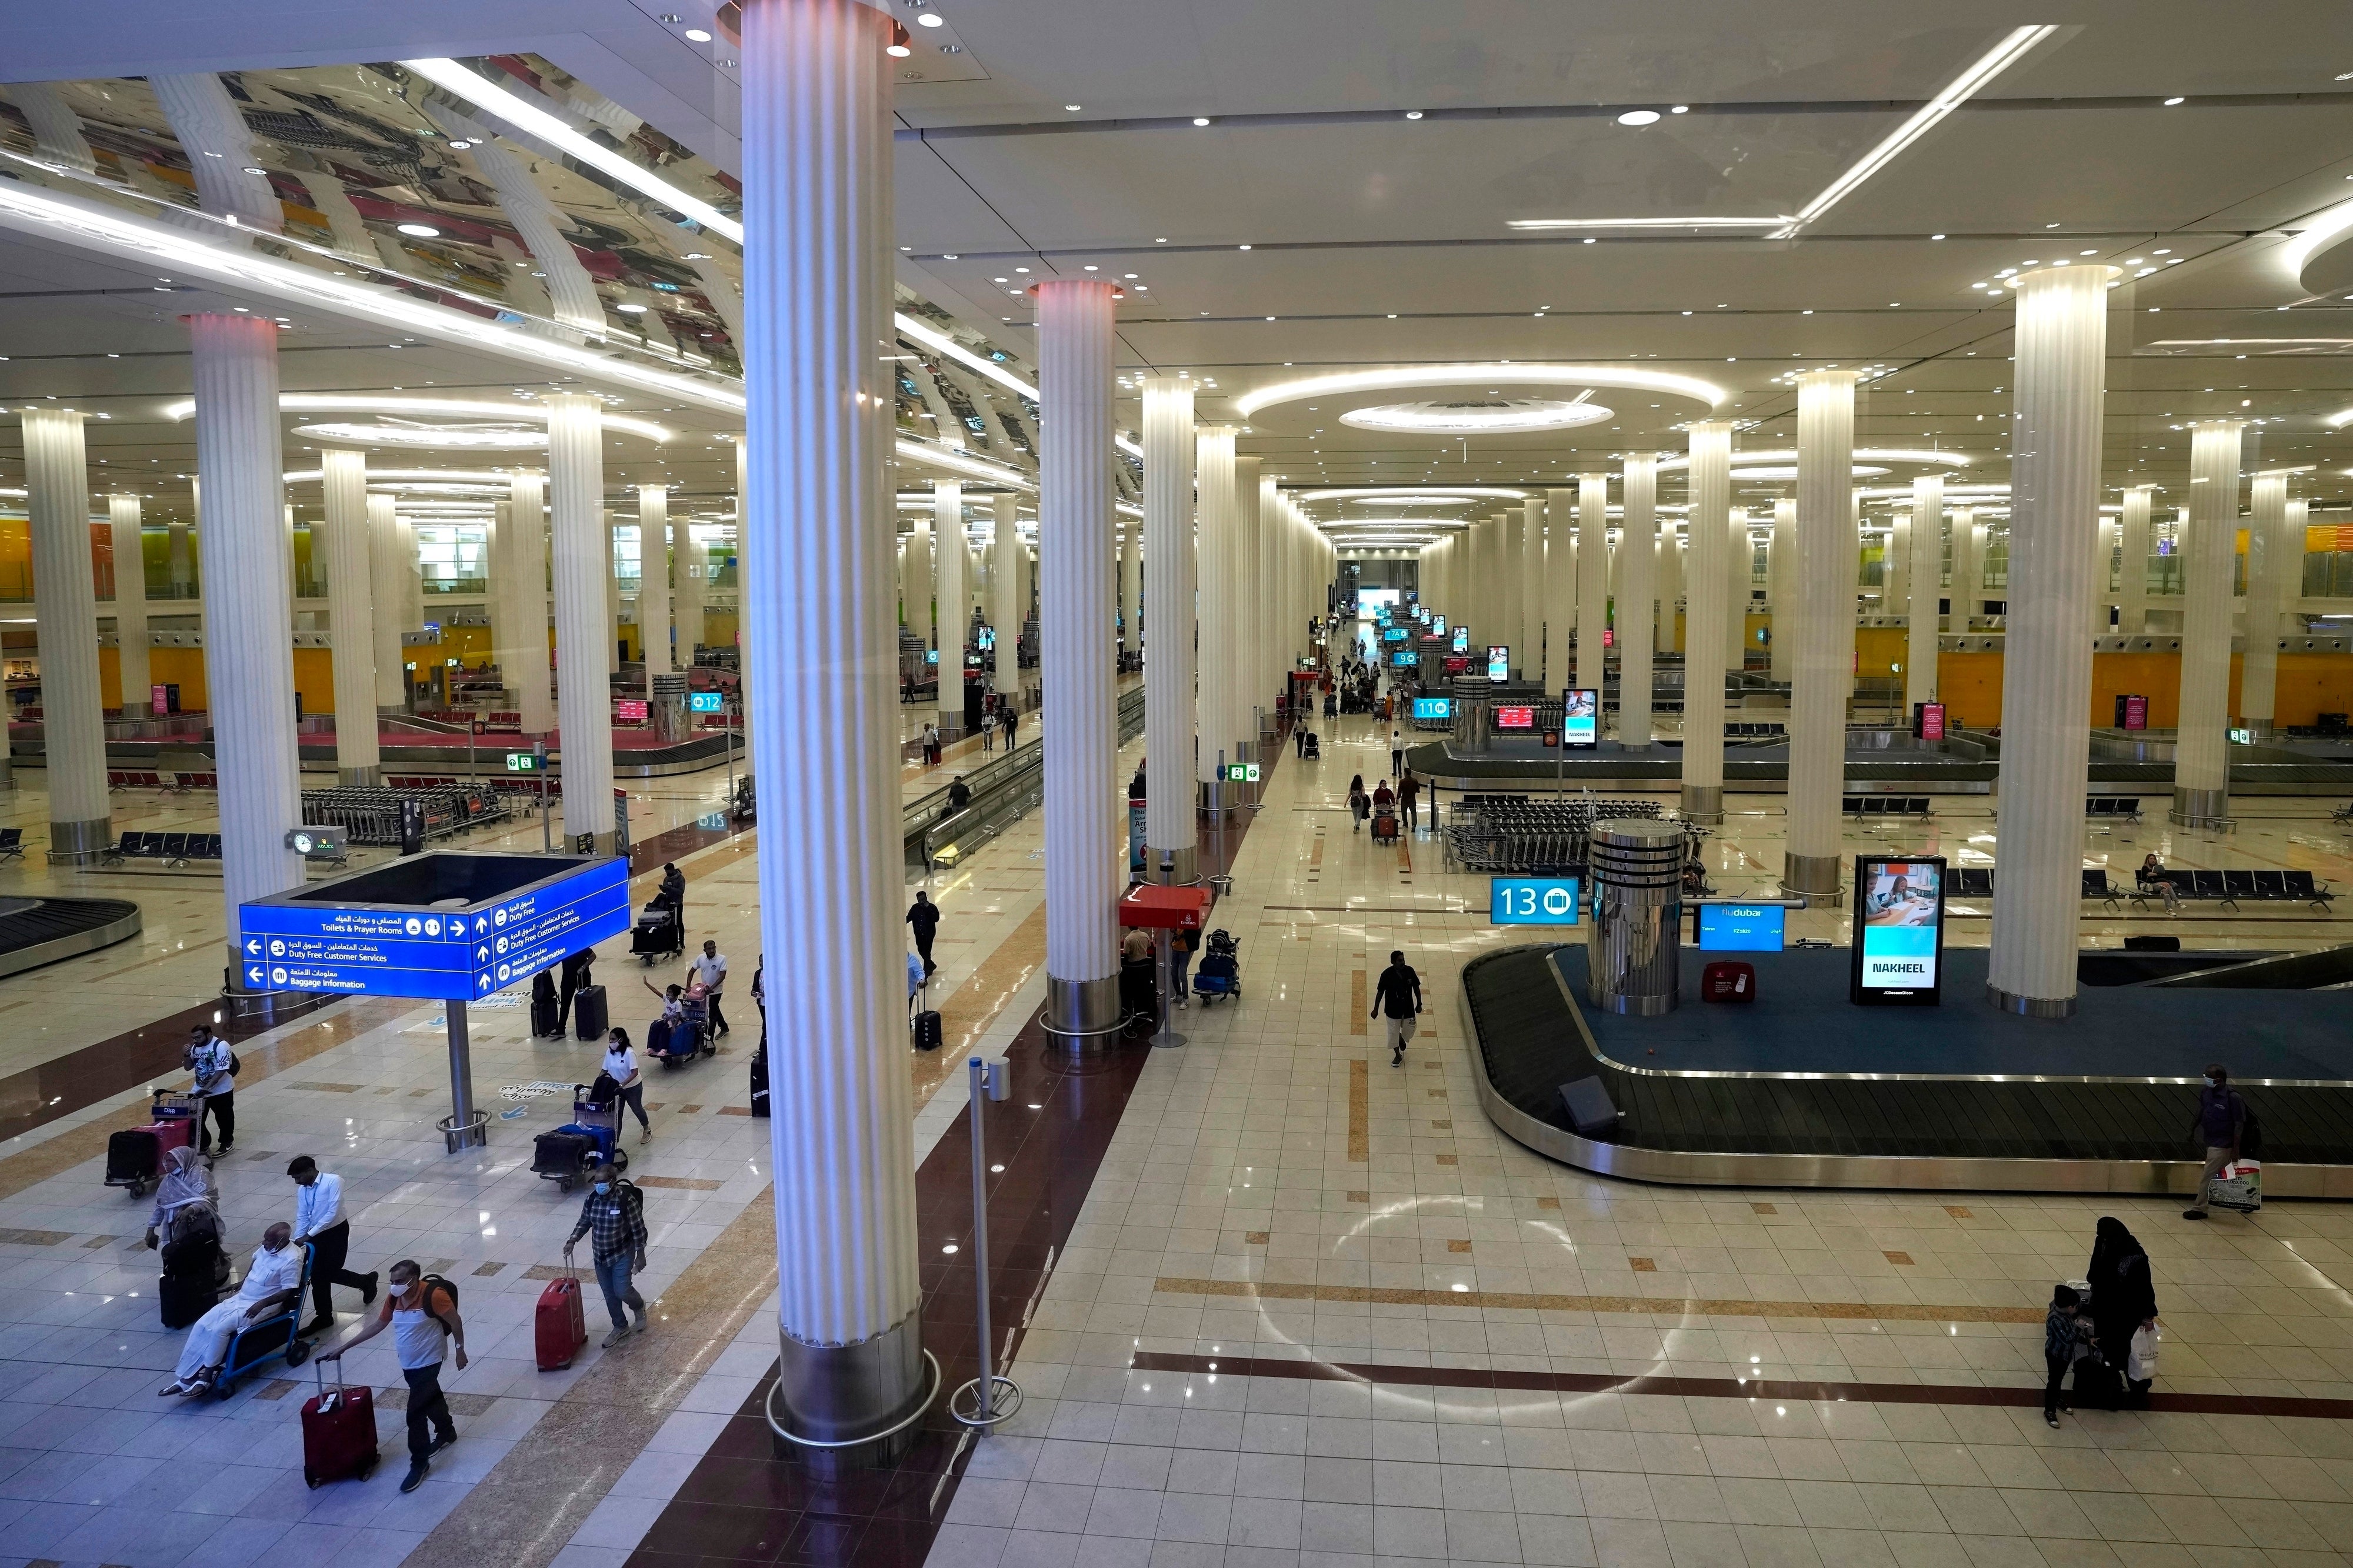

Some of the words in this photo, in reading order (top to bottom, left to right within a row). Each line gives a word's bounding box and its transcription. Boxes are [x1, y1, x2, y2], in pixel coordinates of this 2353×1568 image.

[1400, 655, 1405, 663] 9
[706, 696, 719, 708] 12
[1419, 702, 1433, 715] 11
[520, 897, 535, 910] السوق
[1501, 888, 1537, 915] 13
[509, 903, 519, 913] الحرة
[561, 909, 574, 918] خدمات
[1722, 908, 1761, 917] flydubai
[509, 912, 522, 922] Duty
[523, 908, 535, 916] Free
[539, 913, 561, 929] المتعاملين
[322, 923, 345, 932] Toilets
[354, 926, 376, 935] Prayer
[510, 930, 521, 940] الحرة
[511, 940, 524, 950] Duty
[525, 935, 536, 943] Free
[537, 923, 561, 938] Customer
[561, 916, 580, 928] Services
[521, 924, 536, 937] السوق
[302, 942, 322, 950] السوق
[289, 950, 305, 959] Duty
[324, 952, 358, 960] Customer
[359, 954, 387, 962] Services
[528, 948, 548, 960] معلومات
[512, 961, 536, 977] Baggage
[536, 948, 566, 966] Information
[1873, 963, 1925, 973] NAKHEEL
[291, 978, 321, 988] Baggage
[322, 979, 365, 989] Information
